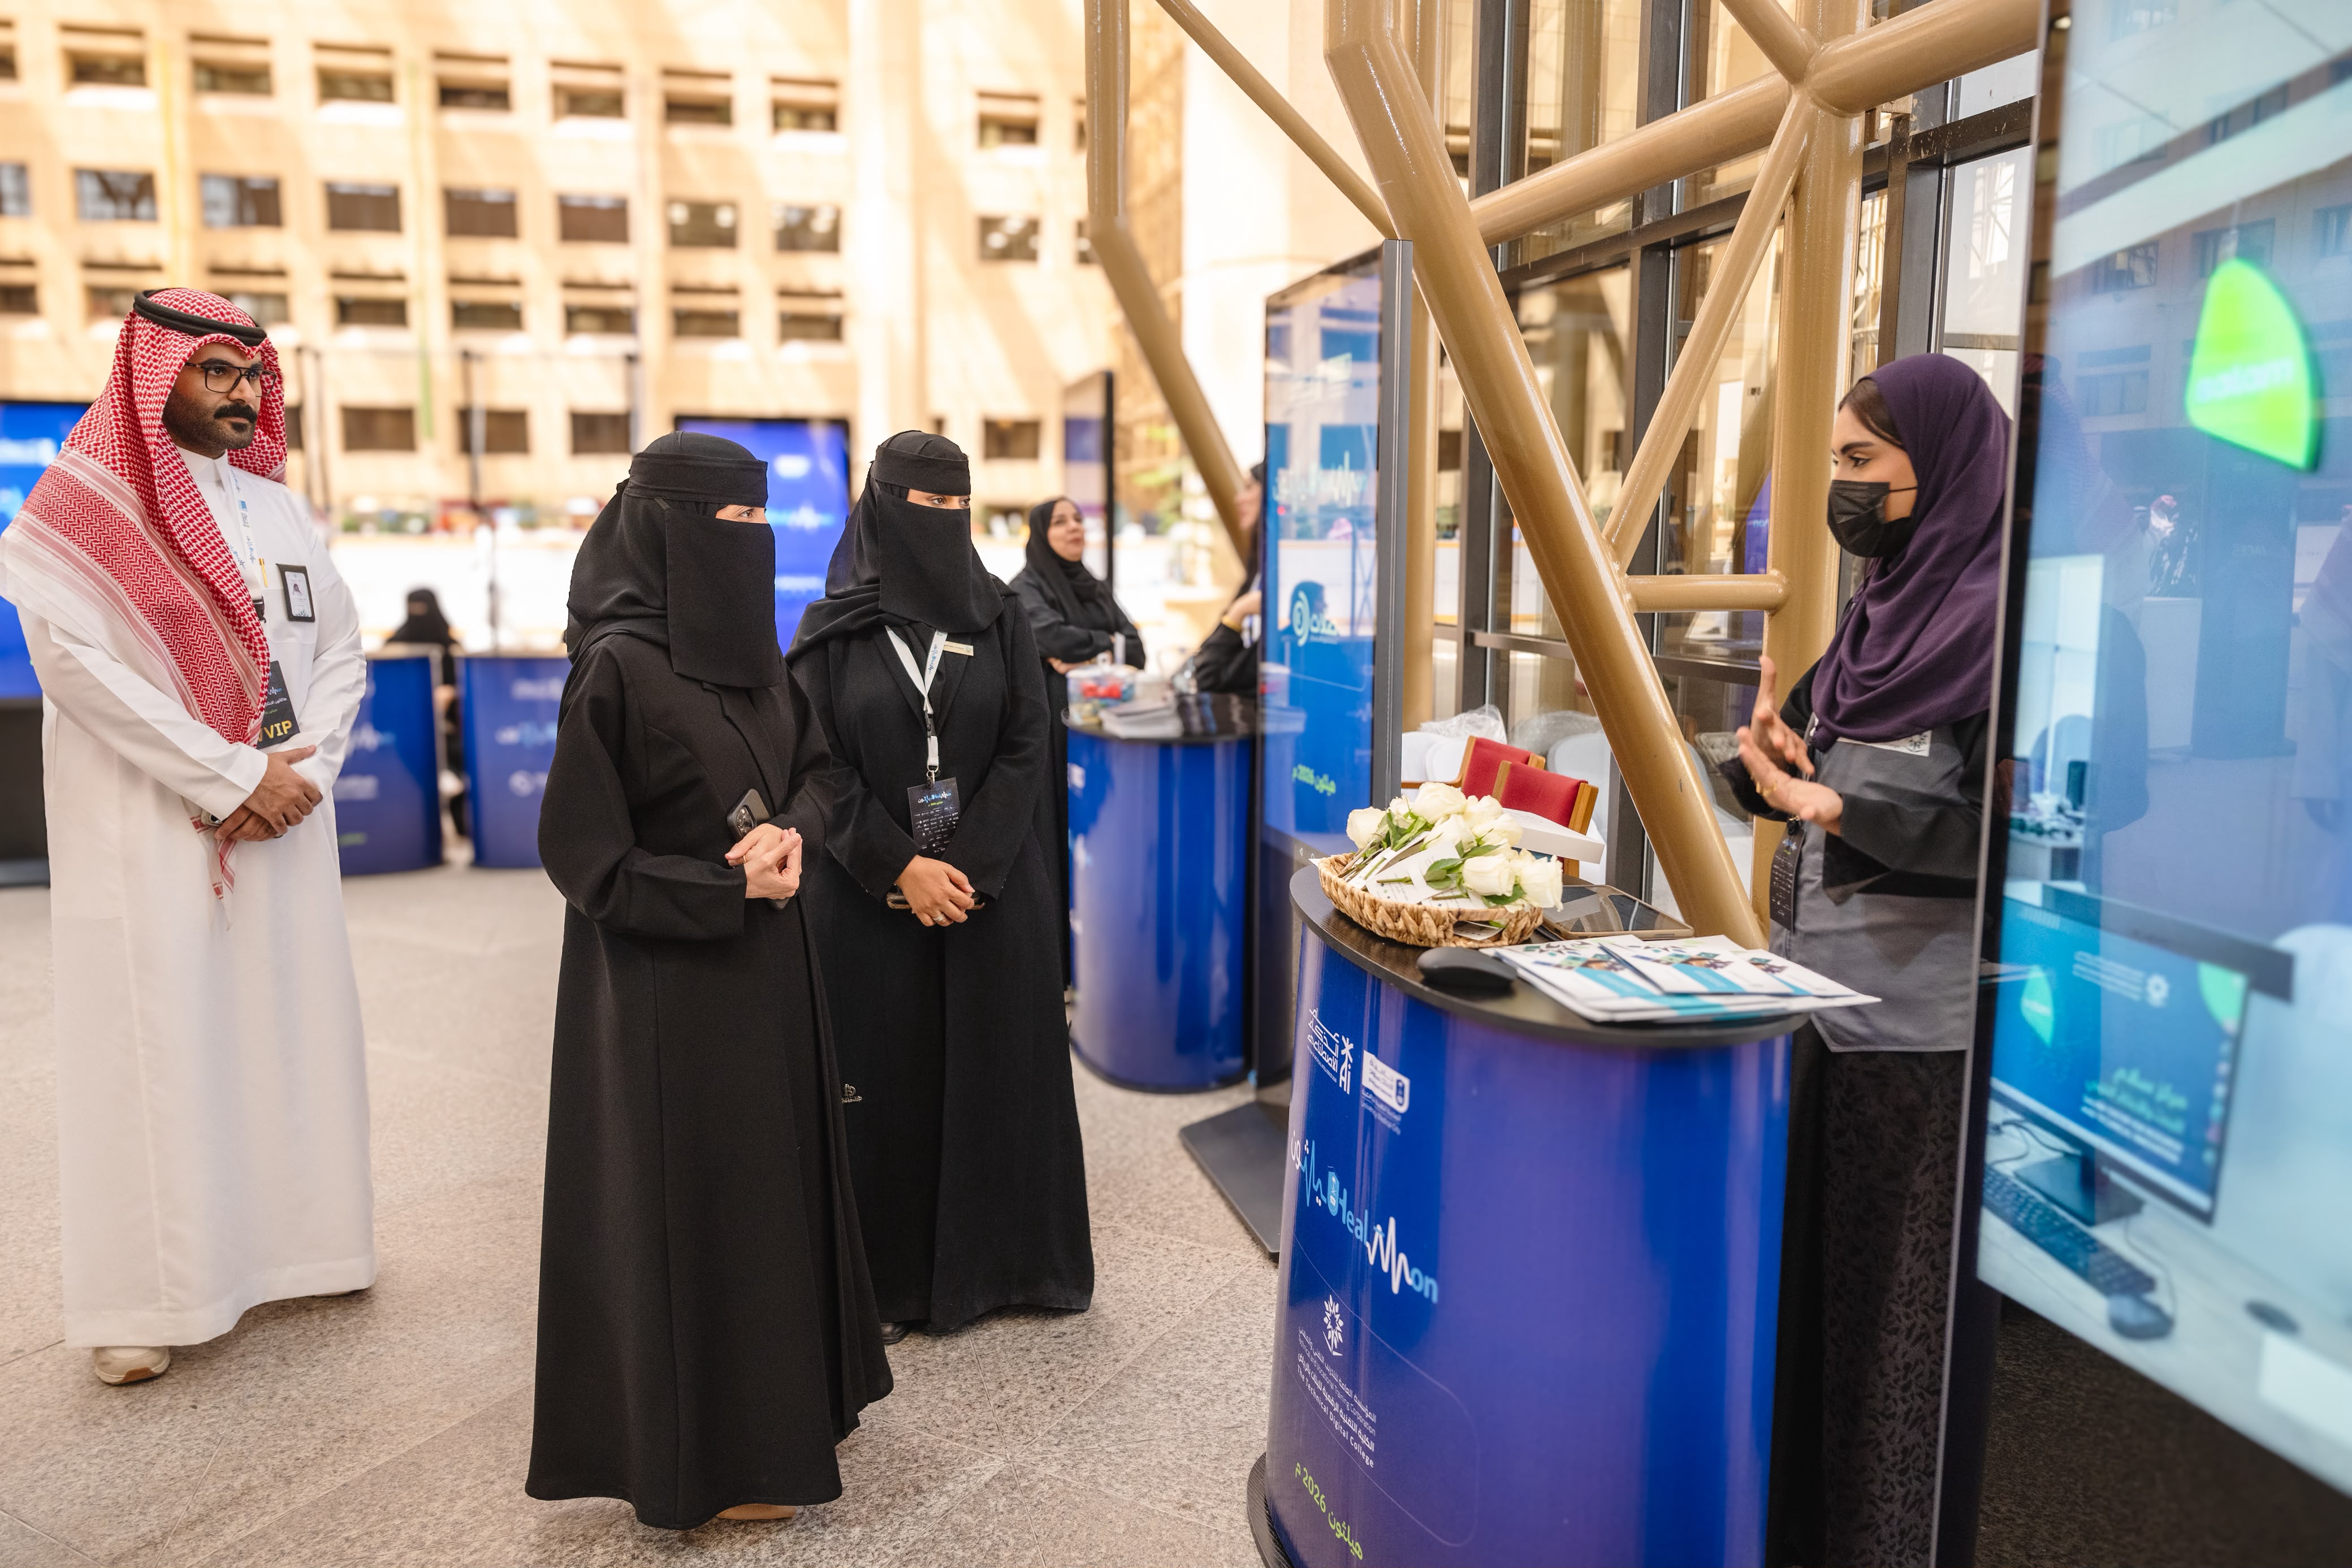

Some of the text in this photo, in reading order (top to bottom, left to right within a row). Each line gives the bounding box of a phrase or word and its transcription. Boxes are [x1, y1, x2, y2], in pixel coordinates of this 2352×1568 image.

[1305, 1377, 1329, 1415] Technical
[1329, 1410, 1349, 1440] Digital
[1350, 1436, 1374, 1469] College
[1303, 1467, 1326, 1513] 2026
[1329, 1511, 1363, 1561] هيلثون
